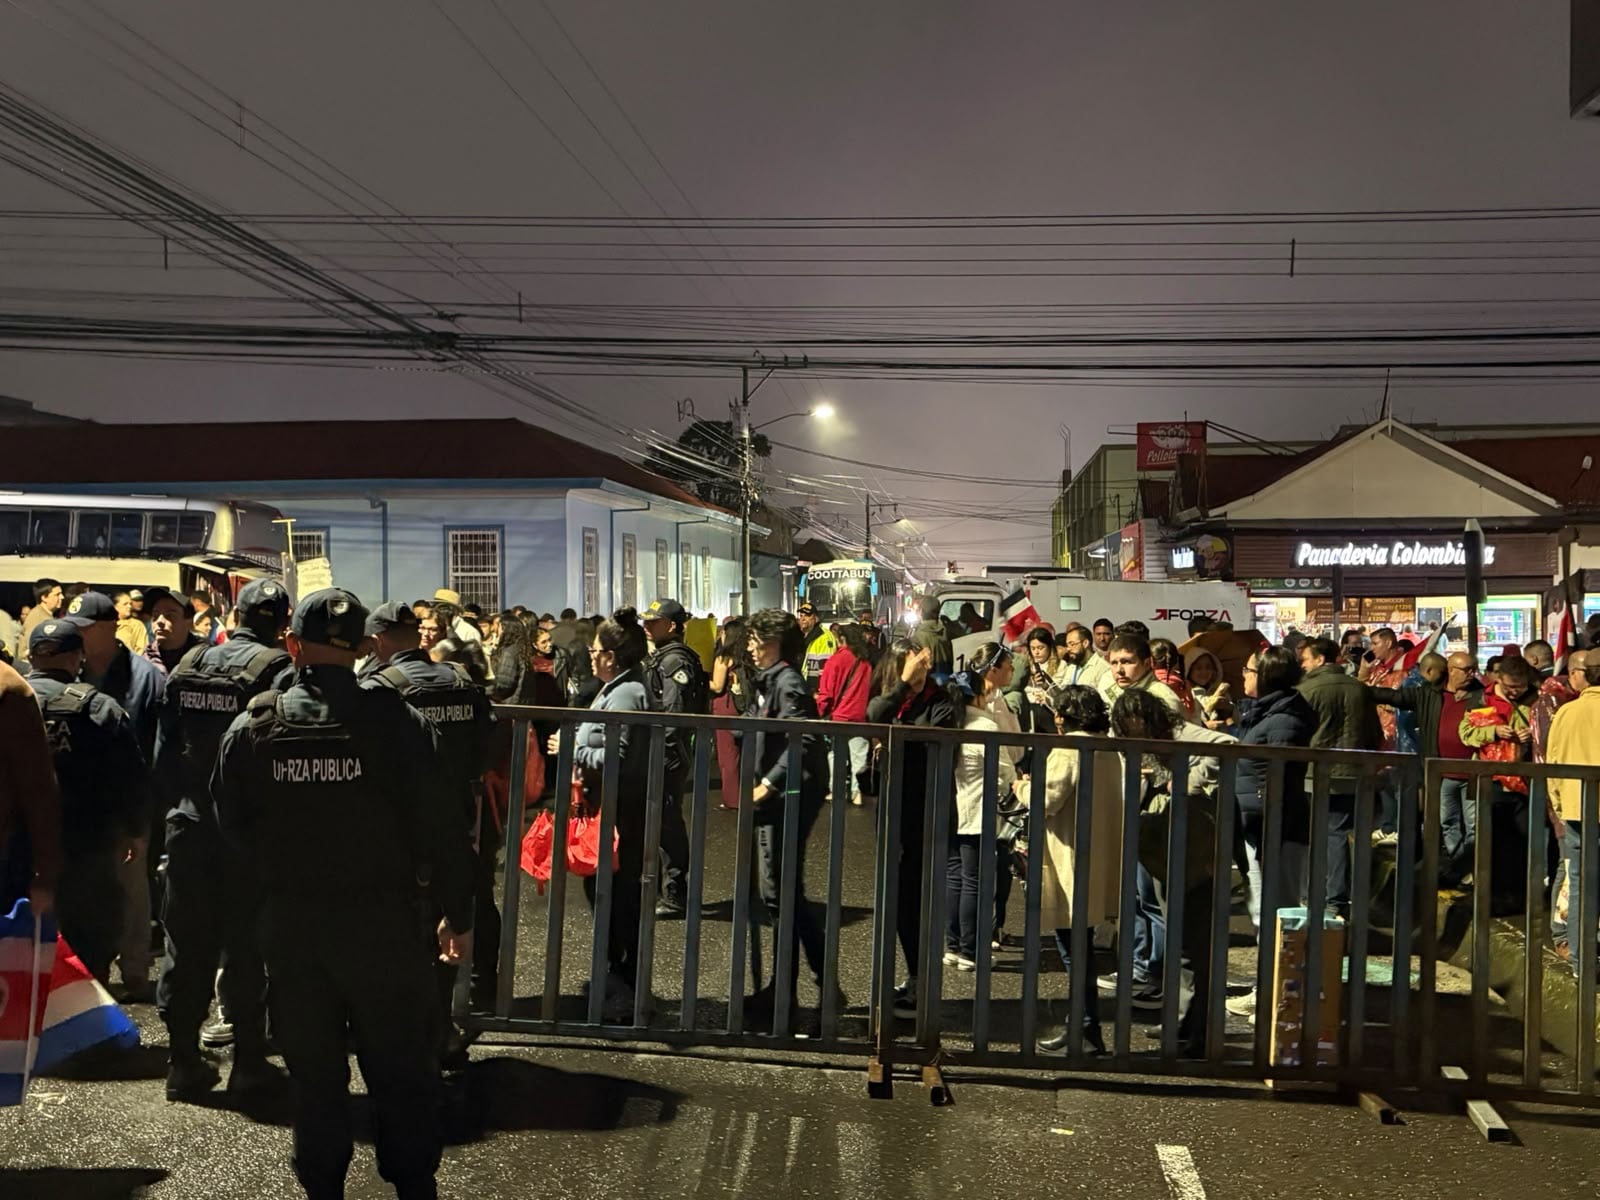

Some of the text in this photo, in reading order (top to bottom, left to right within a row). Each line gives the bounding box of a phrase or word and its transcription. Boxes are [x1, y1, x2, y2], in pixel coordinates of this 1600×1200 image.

[1391, 541, 1496, 565] Colombia
[807, 569, 872, 580] COOTTABUS
[1168, 609, 1232, 621] FORZA
[179, 690, 239, 712] FUERZA PUBLICA
[446, 704, 475, 721] PUBLICA
[312, 757, 362, 782] PUBLICA
